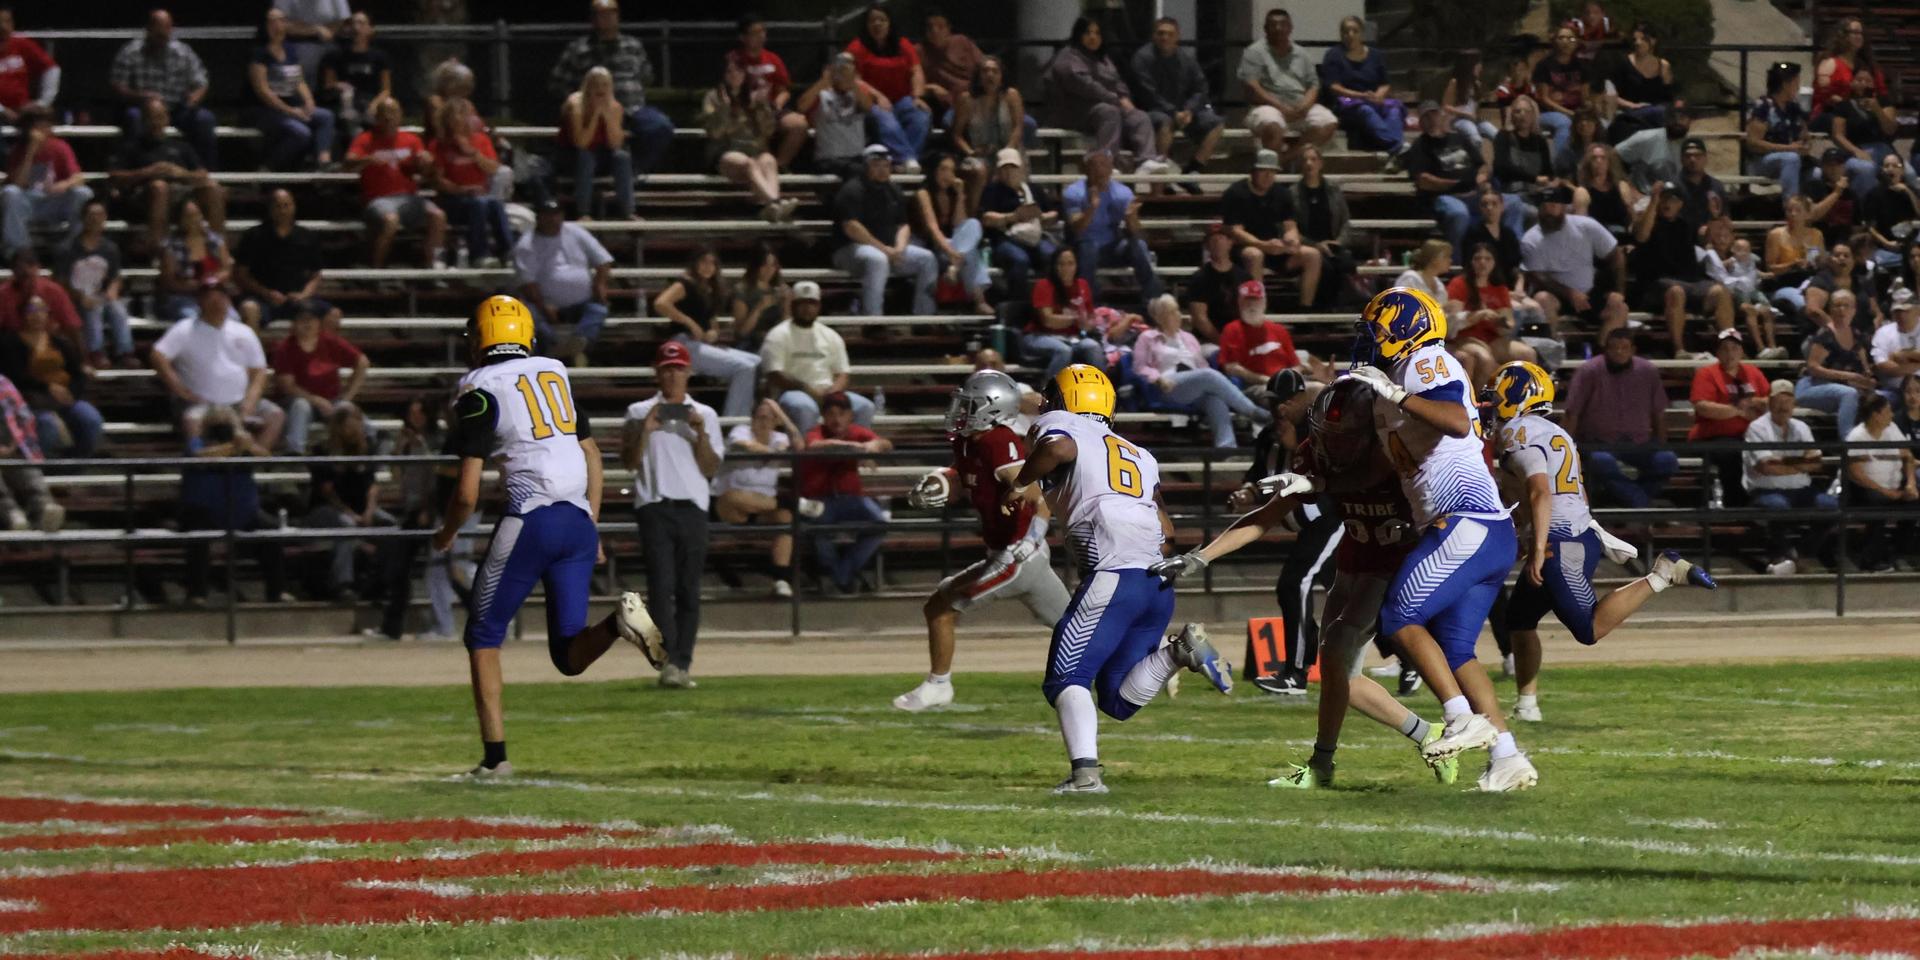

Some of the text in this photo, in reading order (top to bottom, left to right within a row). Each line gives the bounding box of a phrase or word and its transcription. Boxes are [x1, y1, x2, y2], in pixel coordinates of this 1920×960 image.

[1415, 355, 1450, 384] 54
[515, 371, 577, 440] 10
[1503, 426, 1526, 450] 24
[1008, 442, 1019, 461] 4
[1103, 434, 1144, 498] 6
[1343, 502, 1398, 517] TRIBE
